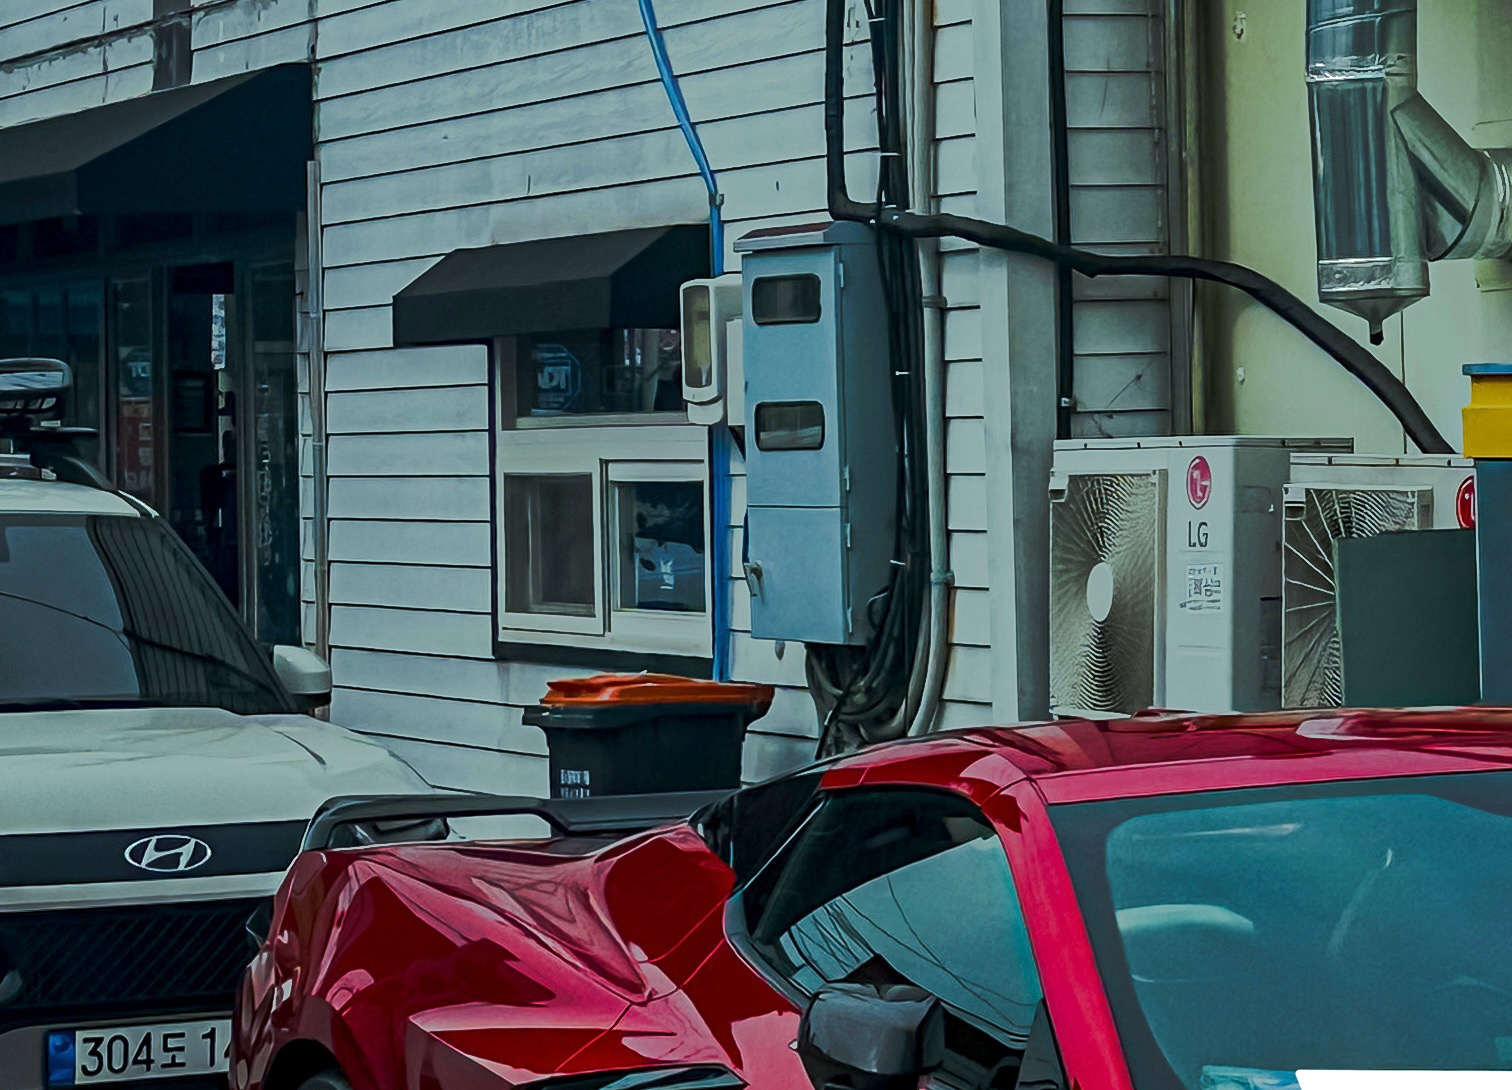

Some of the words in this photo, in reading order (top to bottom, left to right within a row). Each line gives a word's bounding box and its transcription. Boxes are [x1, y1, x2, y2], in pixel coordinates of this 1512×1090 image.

[1188, 521, 1209, 547] LG
[81, 1032, 187, 1076] 304도
[201, 1026, 231, 1068] 1
